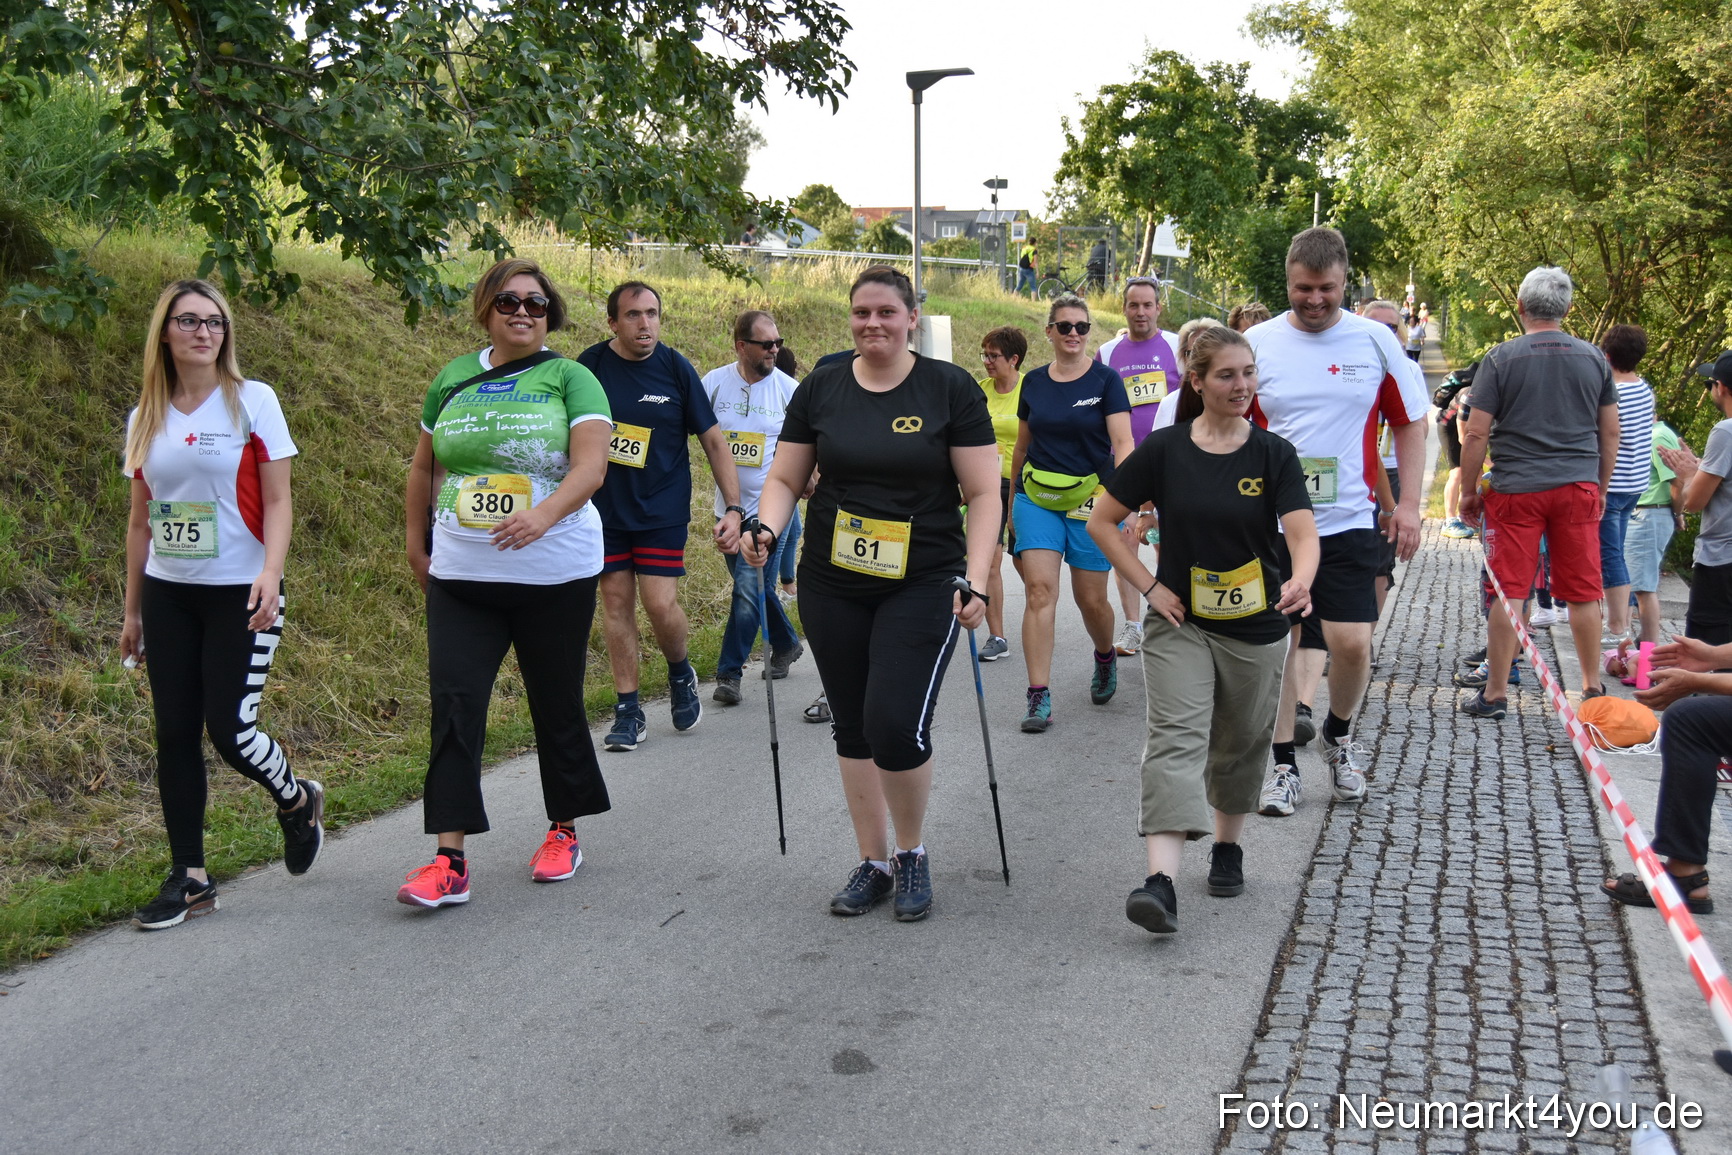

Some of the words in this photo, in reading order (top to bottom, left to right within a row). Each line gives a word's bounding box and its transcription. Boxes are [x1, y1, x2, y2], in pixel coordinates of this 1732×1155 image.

[456, 390, 552, 404] firmenlauf
[1133, 383, 1157, 397] 917
[454, 402, 493, 410] neumarkt
[733, 402, 780, 418] doktor
[485, 411, 543, 421] Firmen
[444, 424, 489, 437] laufen
[496, 420, 553, 435] länger!
[610, 436, 641, 455] 426
[728, 443, 758, 457] 096
[471, 493, 514, 514] 380
[1078, 497, 1094, 510] 4
[162, 522, 200, 542] 375
[854, 537, 880, 560] 61
[837, 551, 869, 565] Großhauser
[870, 560, 899, 570] Franziska
[1214, 587, 1243, 606] 76
